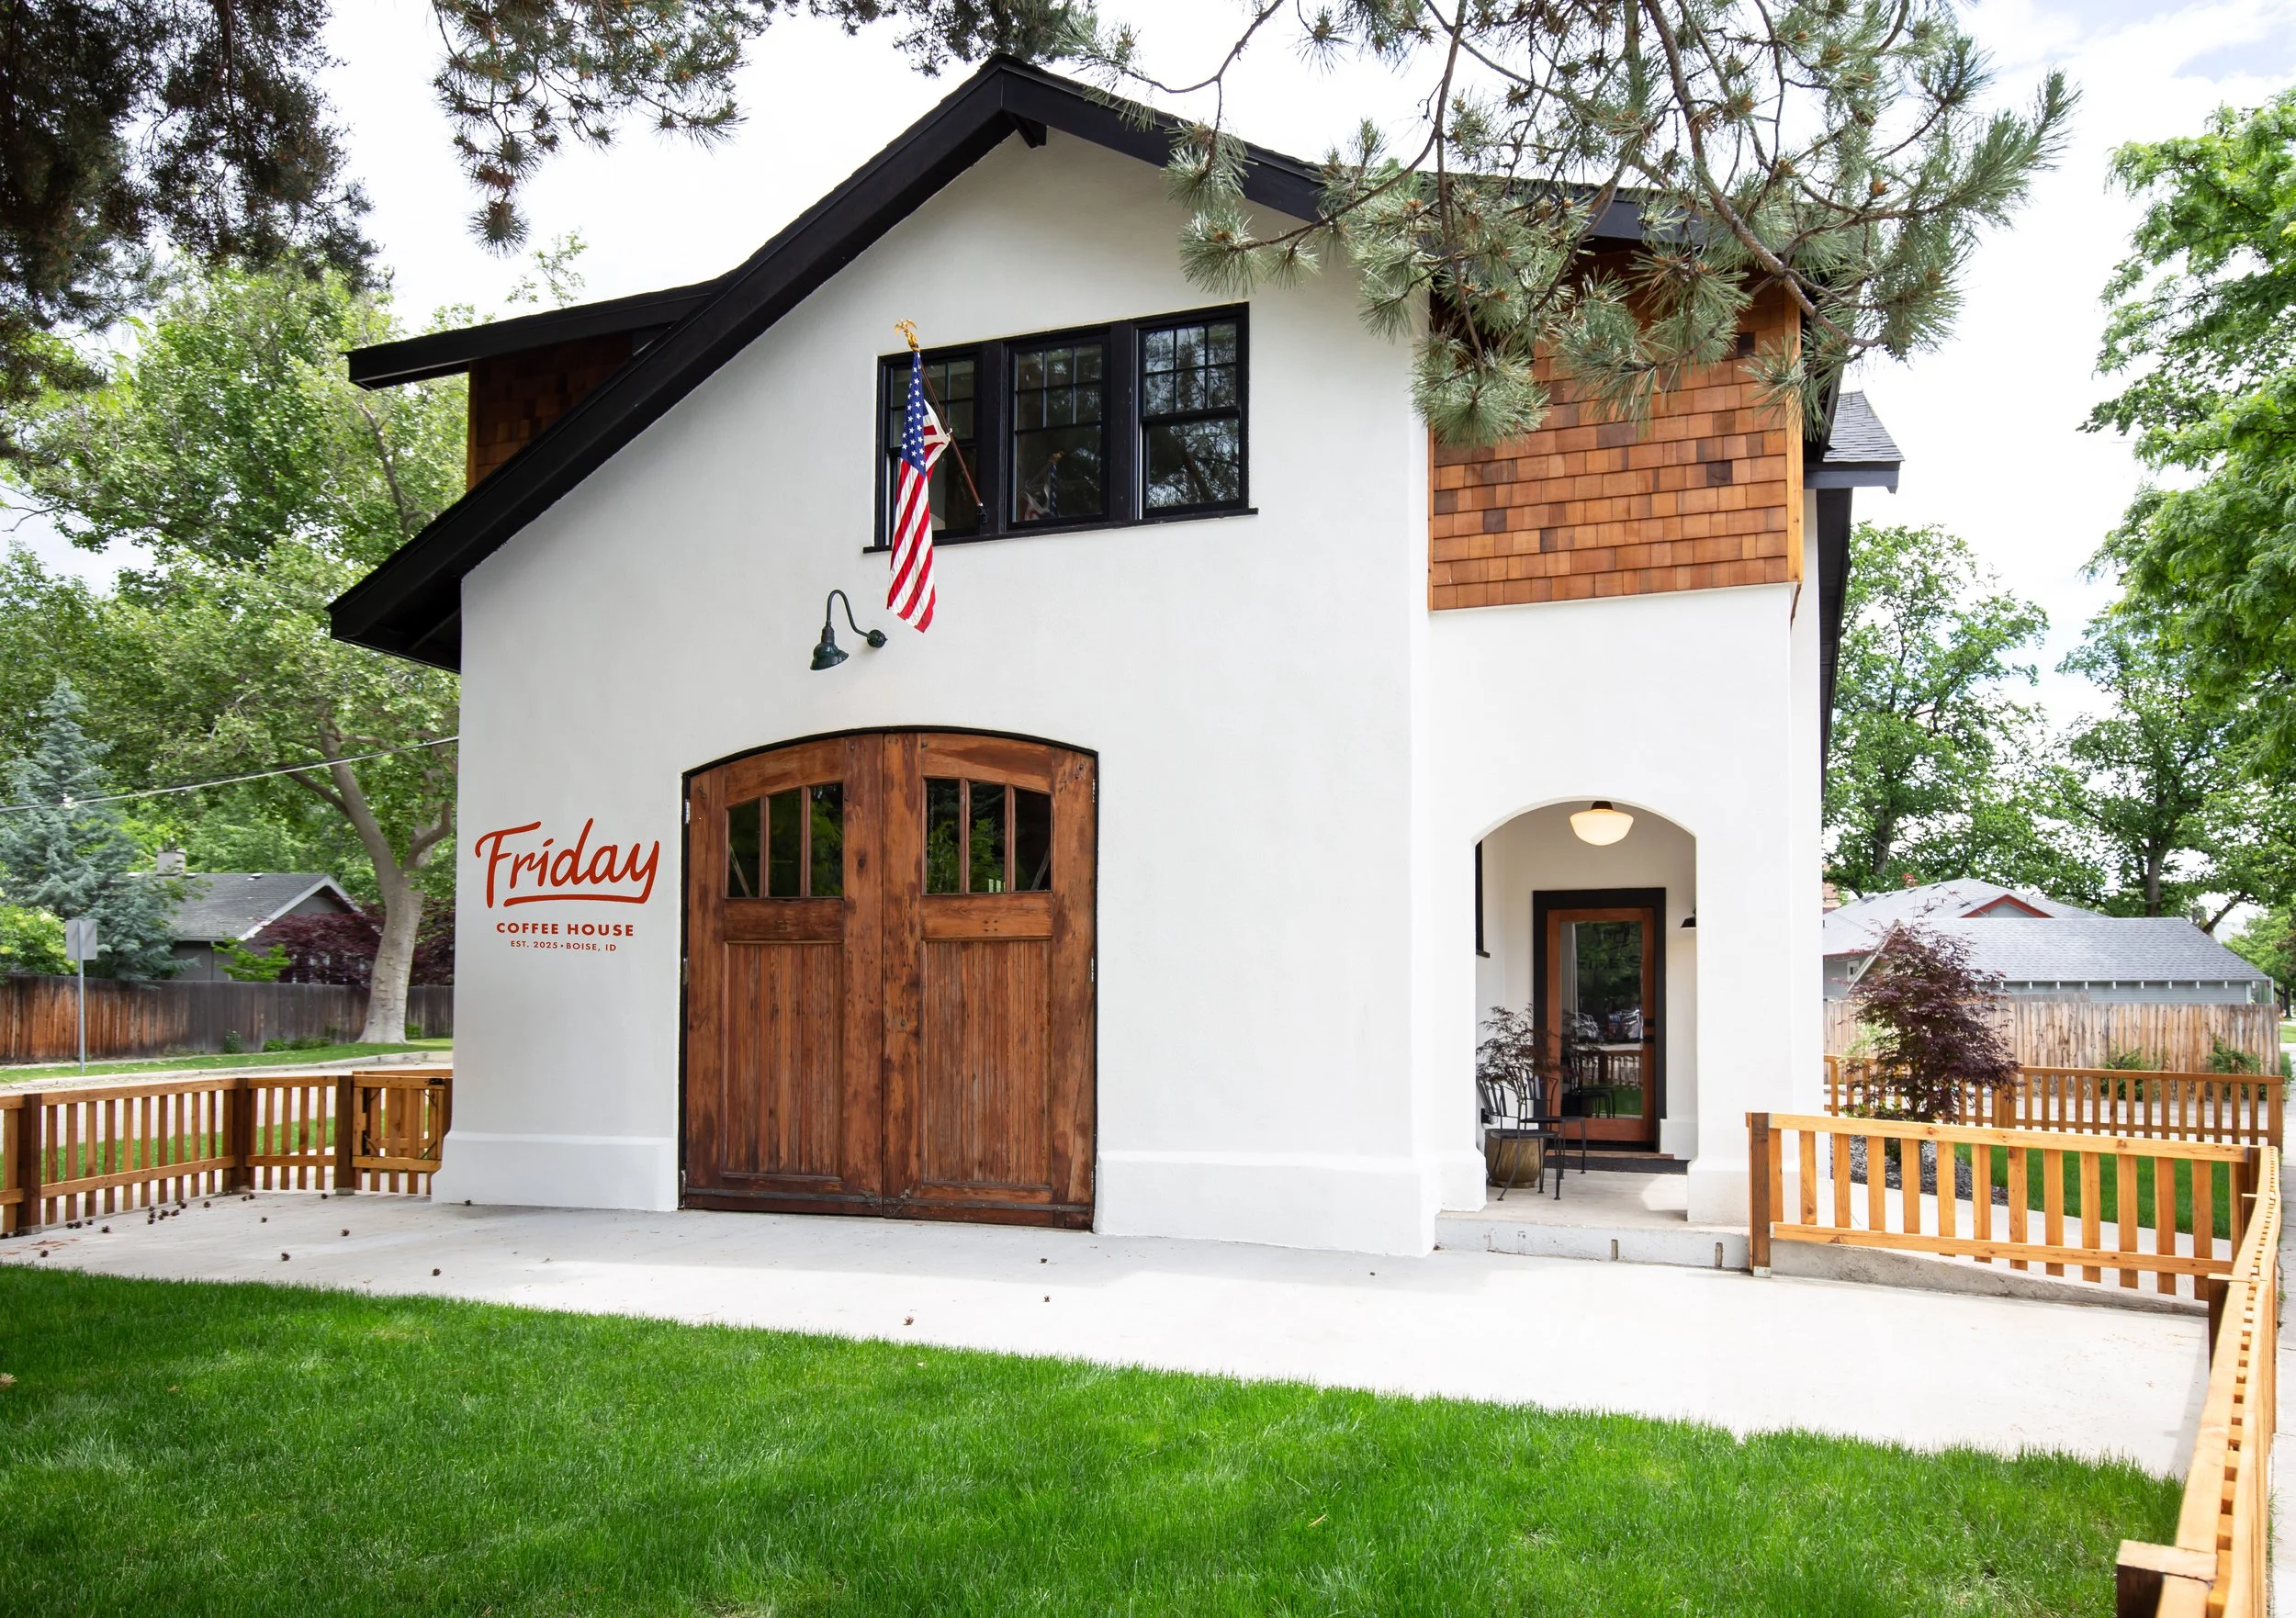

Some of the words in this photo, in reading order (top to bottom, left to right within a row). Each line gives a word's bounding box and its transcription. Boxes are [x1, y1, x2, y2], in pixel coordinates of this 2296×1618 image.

[474, 817, 660, 909] Friday
[496, 922, 559, 935] COFFEE
[567, 923, 635, 938] HOUSE
[533, 941, 558, 949] 2025
[566, 942, 602, 952] BOISE,
[605, 943, 617, 952] ID
